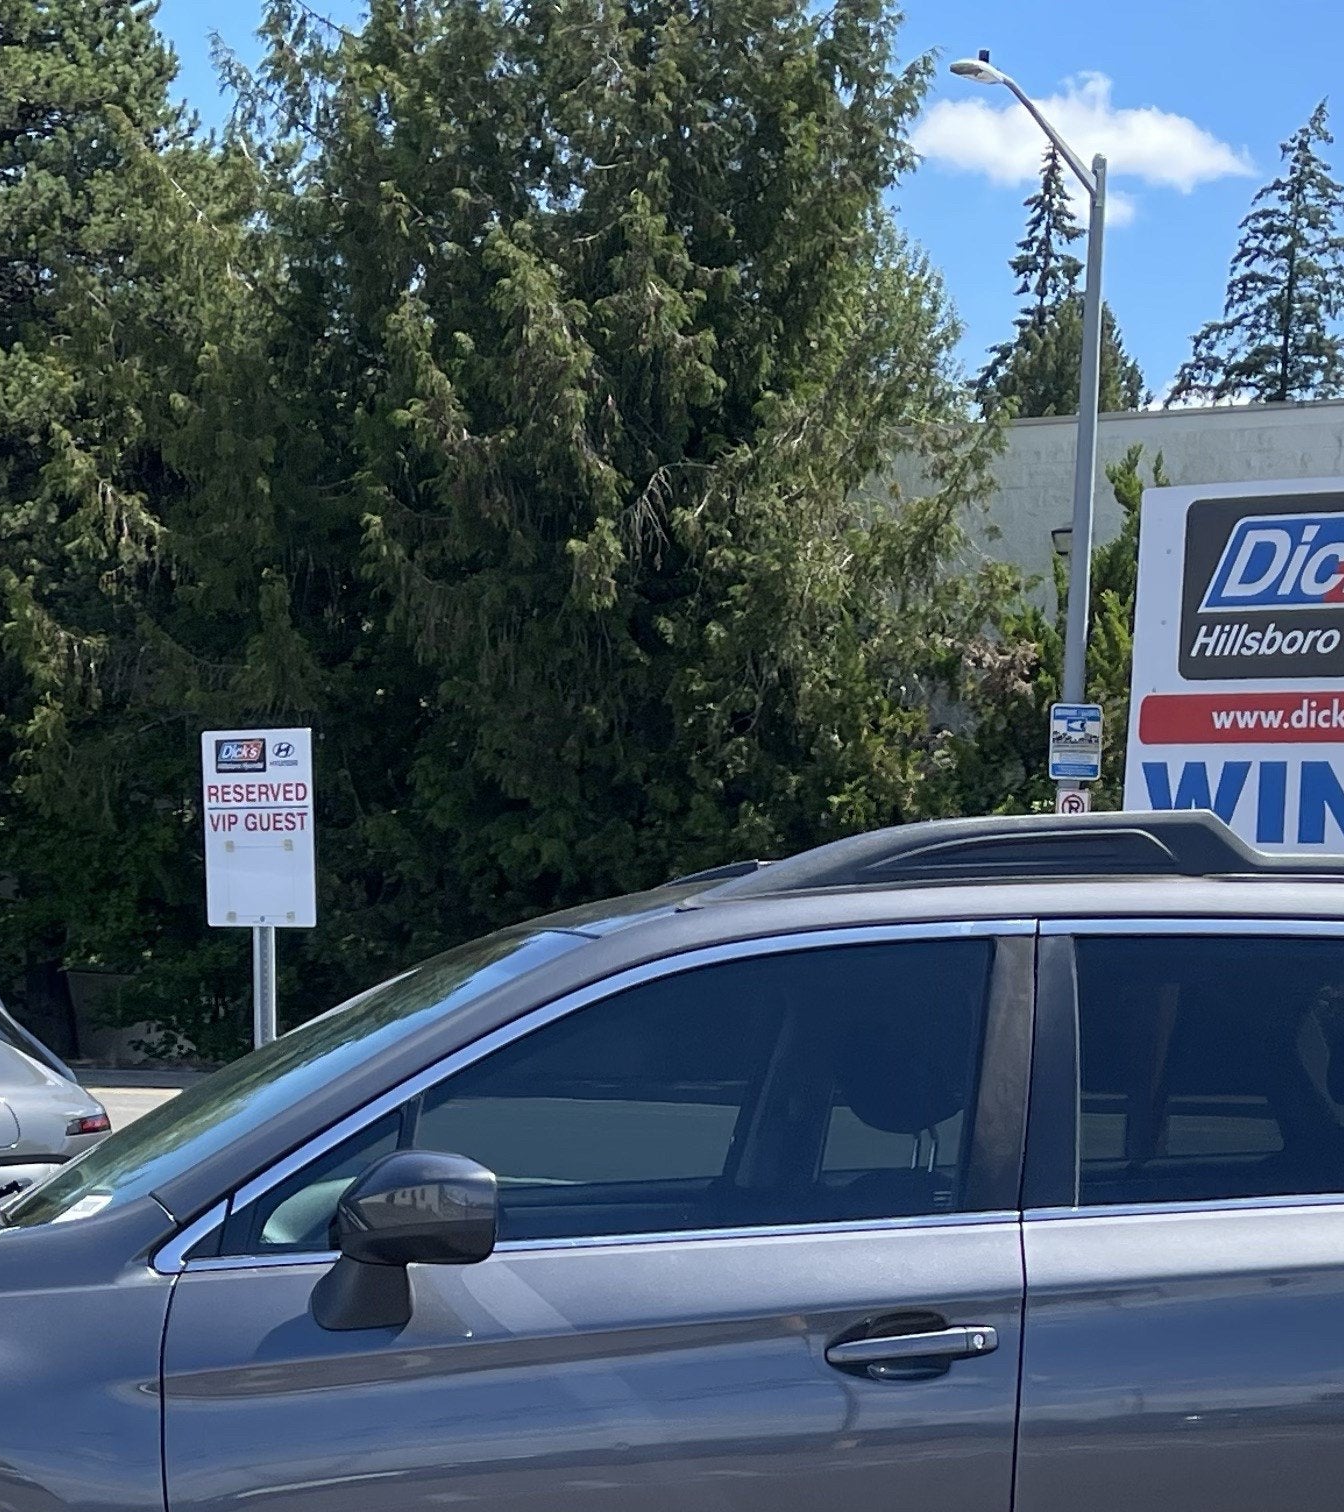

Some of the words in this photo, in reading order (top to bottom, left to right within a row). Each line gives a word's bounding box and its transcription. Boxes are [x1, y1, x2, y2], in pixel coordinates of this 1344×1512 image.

[1190, 621, 1341, 658] Hillsboro
[207, 782, 307, 802] RESERVED
[209, 813, 238, 832] VIP
[244, 812, 308, 831] GUEST
